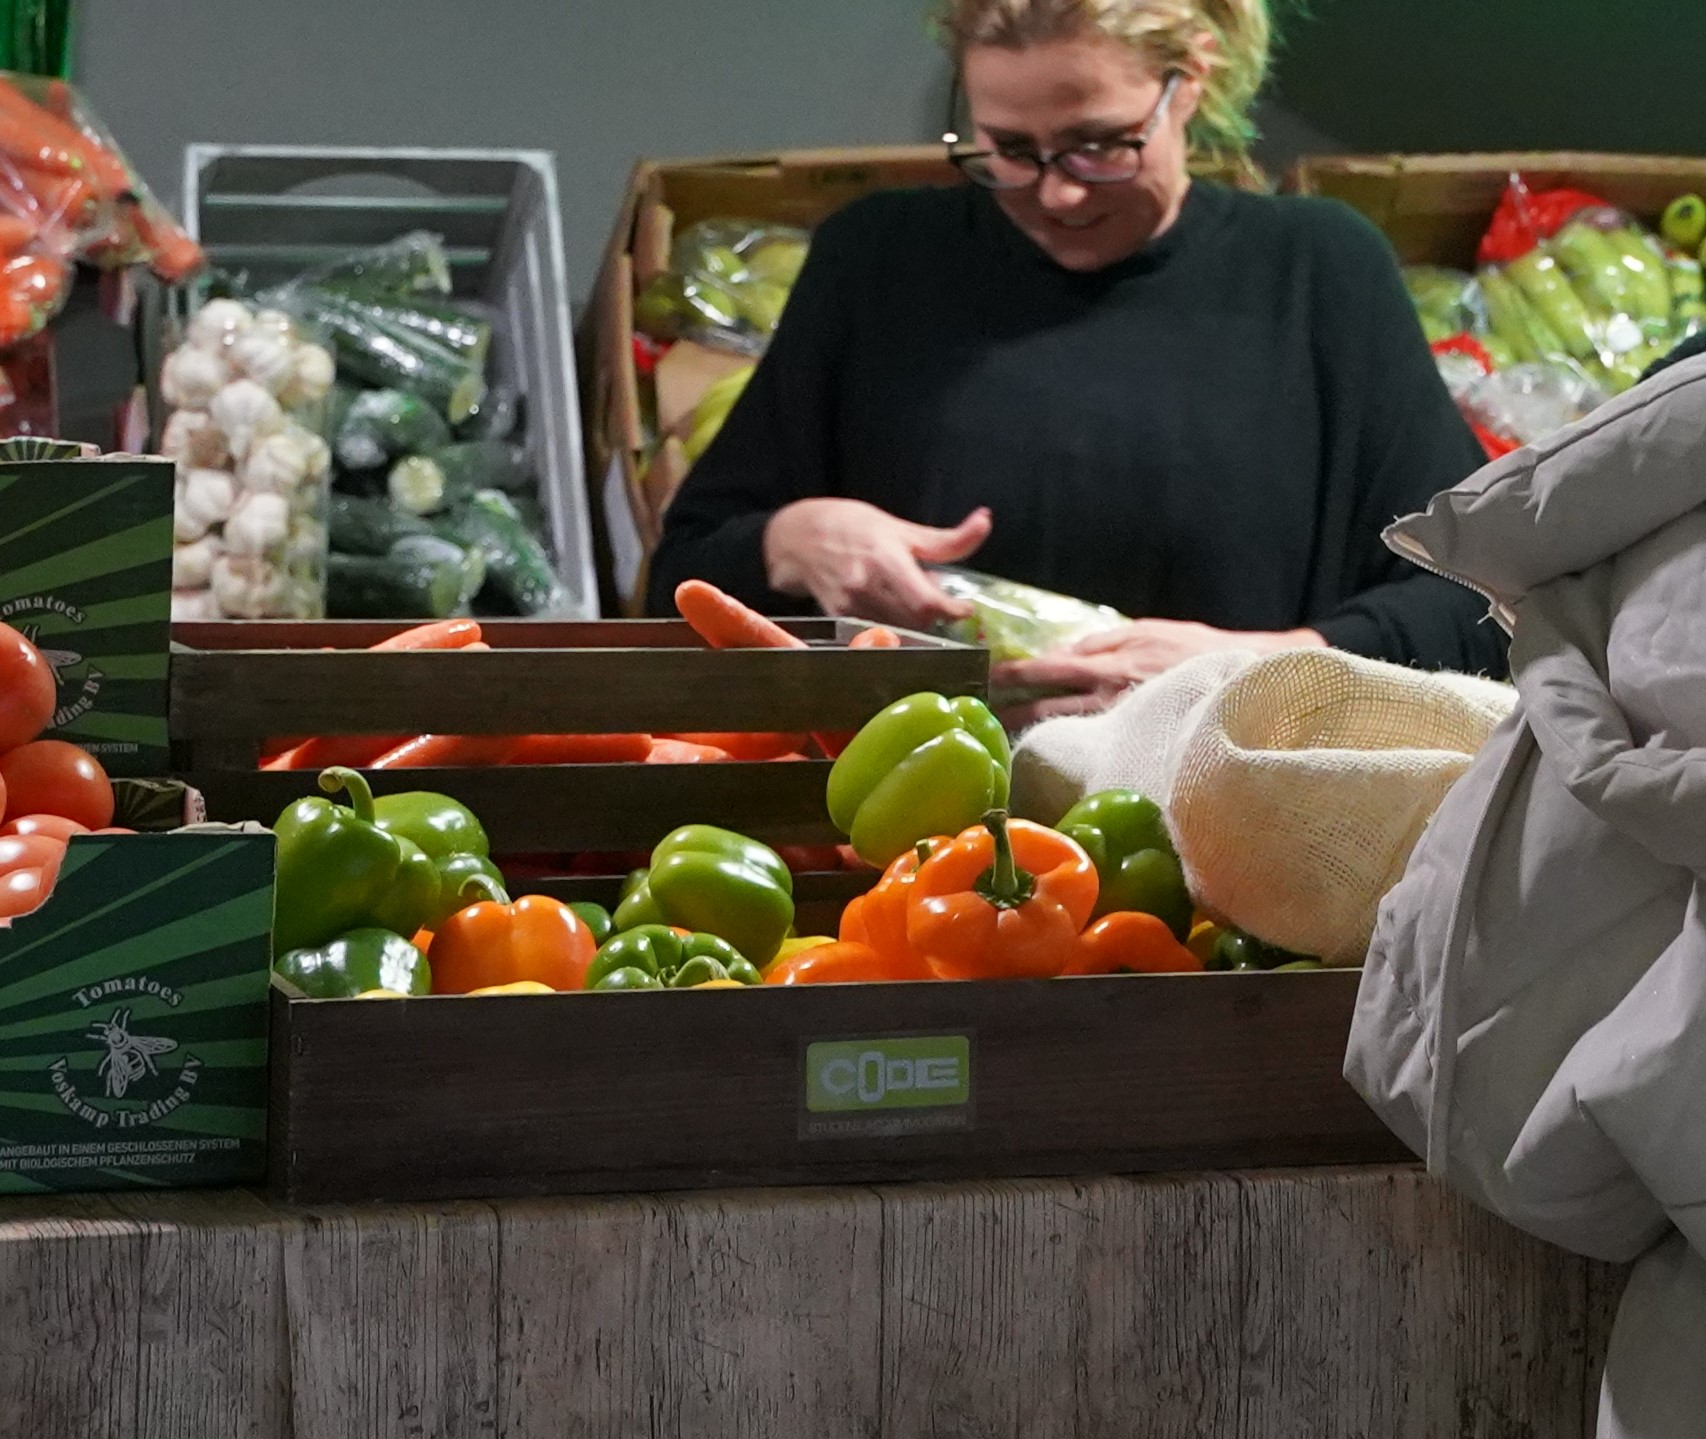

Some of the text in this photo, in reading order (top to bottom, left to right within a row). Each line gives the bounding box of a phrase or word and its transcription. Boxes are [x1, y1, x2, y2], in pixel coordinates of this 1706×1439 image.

[0, 595, 86, 624] omatoes
[47, 697, 94, 730] ding
[100, 743, 138, 754] SYSTEM
[72, 975, 182, 1008] Tomatoes
[49, 1053, 203, 1128] Voskamp Trading BV
[821, 1051, 959, 1103] CODE
[0, 1137, 240, 1157] ANGEBAUT IN EINEM GESCHLOSSENEN SYSTEM
[0, 1152, 196, 1170] MIT BIOLOGISCHEM PFLANZENSCHUTZ
